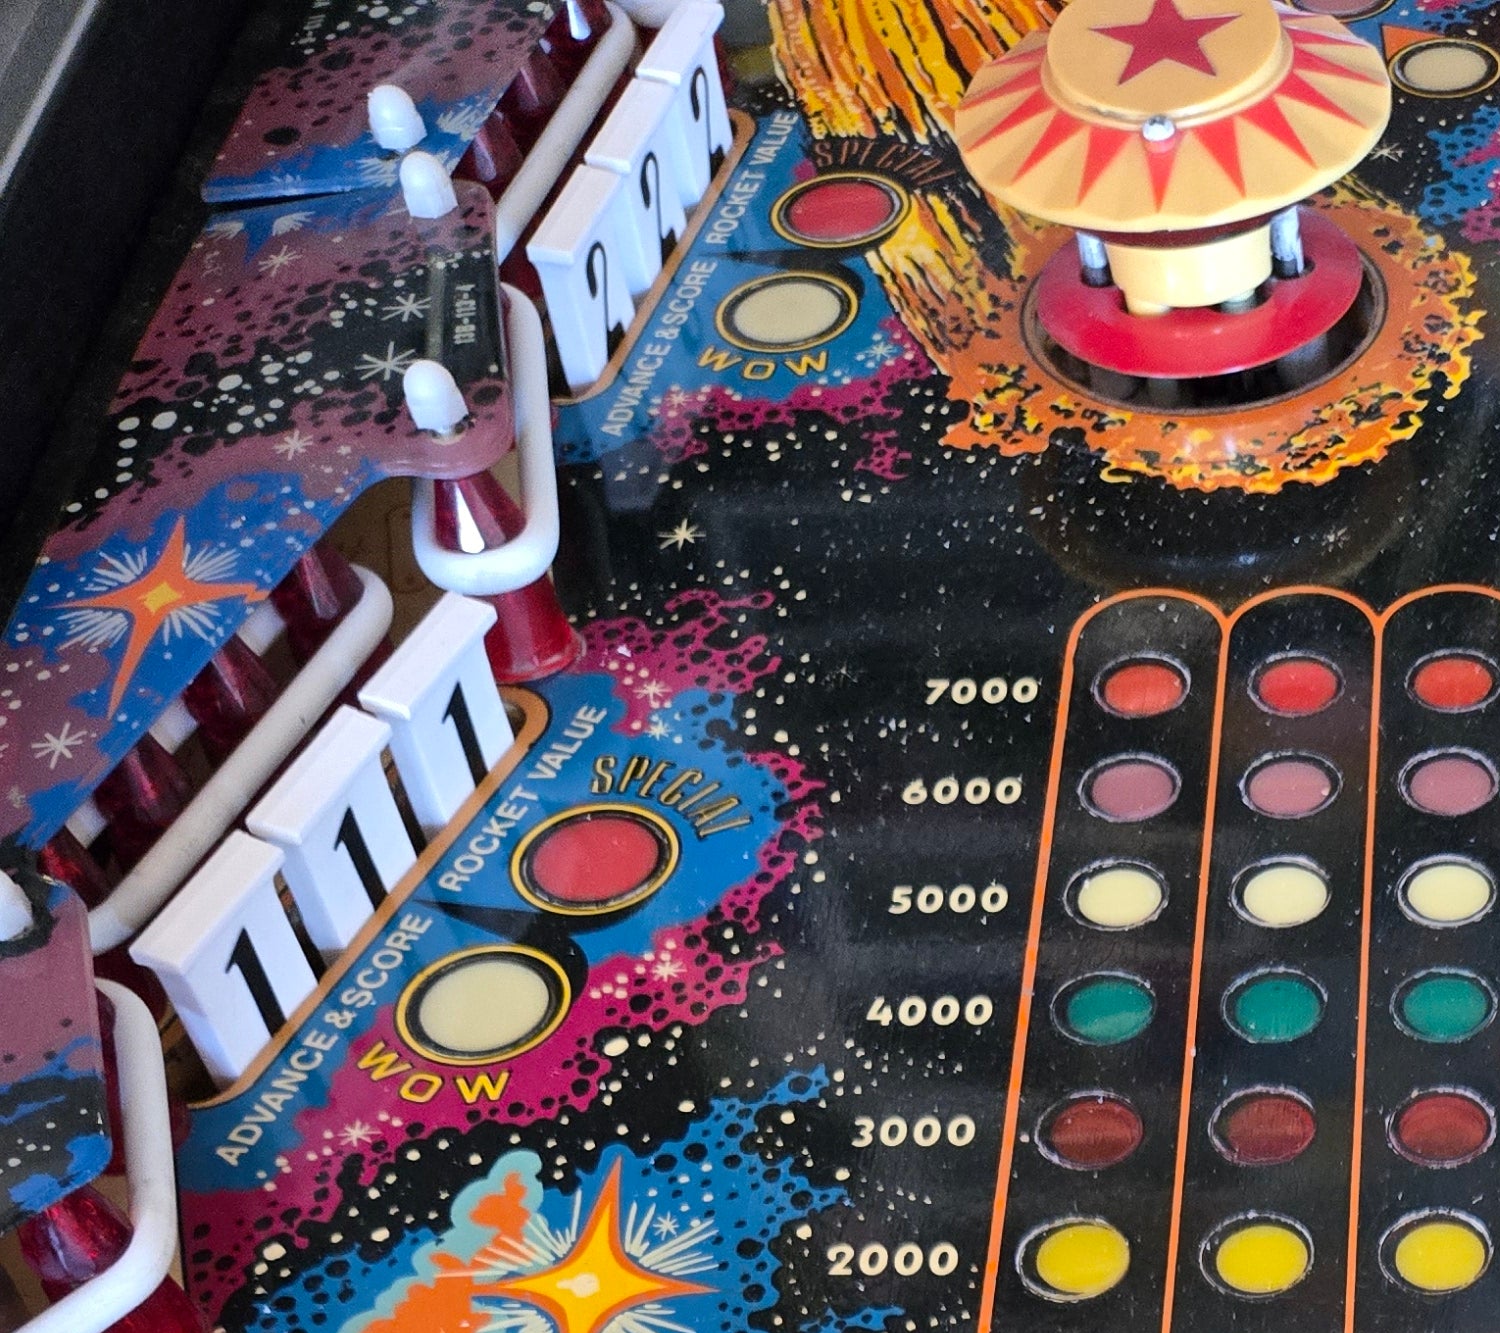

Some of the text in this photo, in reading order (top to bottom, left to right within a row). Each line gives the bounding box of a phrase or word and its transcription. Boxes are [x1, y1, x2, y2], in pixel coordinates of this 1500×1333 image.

[601, 343, 671, 438] ADVANCE
[662, 259, 718, 333] SCORE
[705, 171, 764, 246] ROCKET
[753, 111, 799, 169] VALUE
[698, 346, 830, 381] WOW
[923, 676, 1040, 706] 7000
[442, 682, 488, 788] 1
[590, 754, 752, 838] SPECIAL
[901, 775, 1024, 806] 6000
[334, 807, 388, 912] 1
[887, 883, 1010, 916] 5000
[215, 705, 607, 1167] ADVANCE & SCORE ROCKET VALUE
[225, 927, 287, 1037] 1
[864, 993, 994, 1028] 4000
[356, 1041, 511, 1103] WOW
[850, 1113, 977, 1149] 3000
[825, 1241, 960, 1277] 2000
